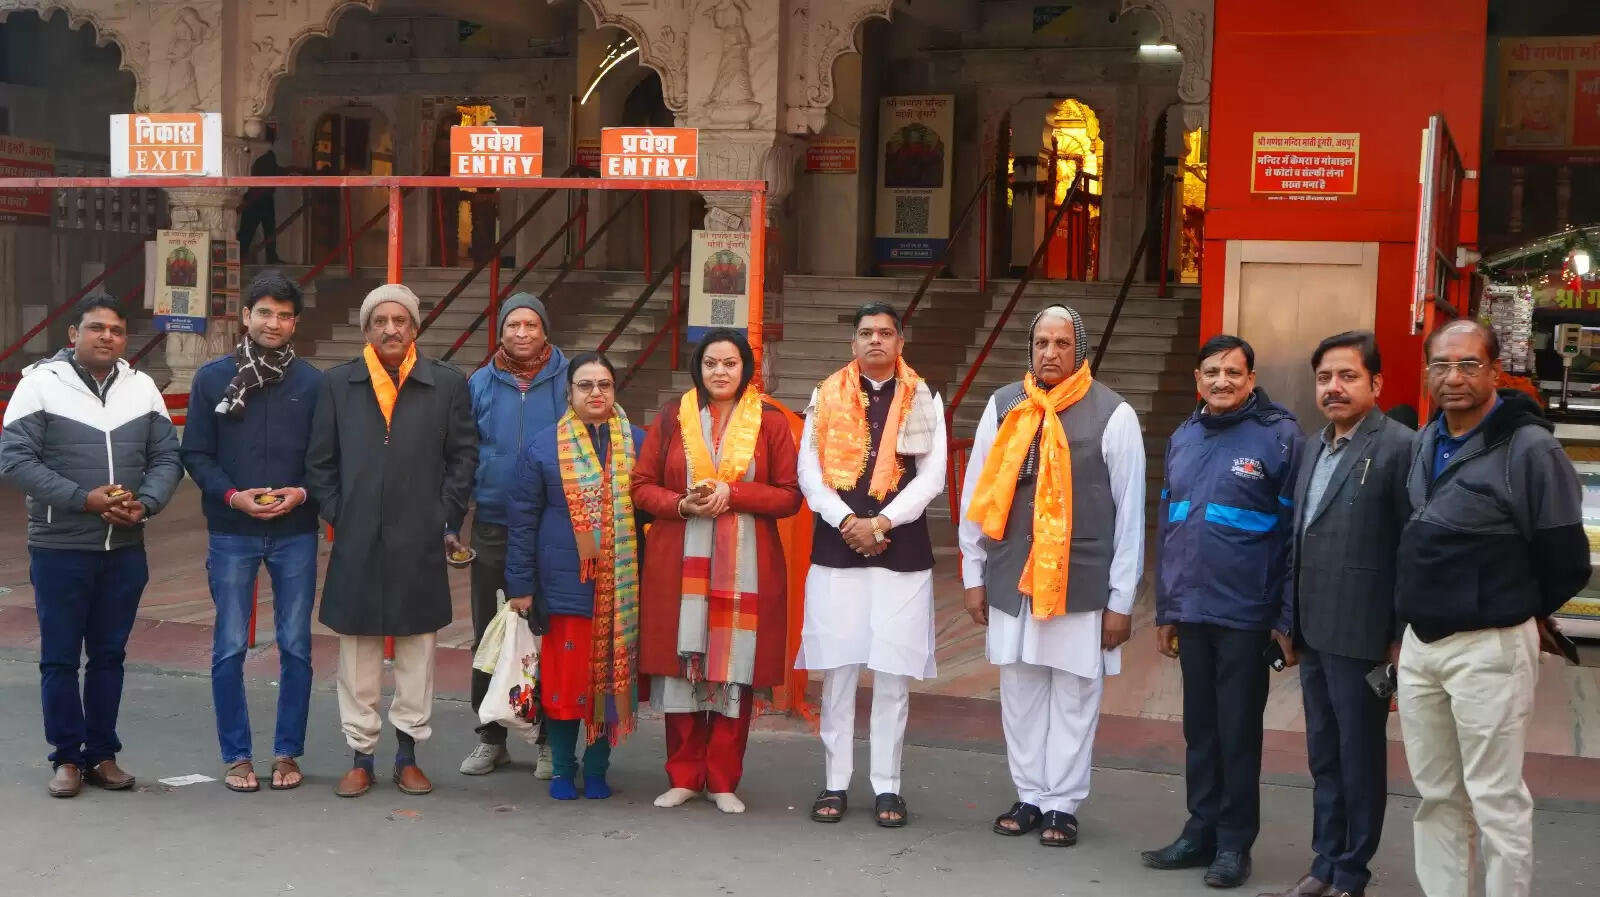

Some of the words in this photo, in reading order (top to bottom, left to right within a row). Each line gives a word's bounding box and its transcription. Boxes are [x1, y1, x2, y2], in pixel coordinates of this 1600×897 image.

[136, 116, 196, 144] निकास
[470, 127, 523, 152] प्रवेश
[621, 129, 677, 153] प्रवेश
[136, 151, 196, 171] EXIT
[458, 155, 534, 175] ENTRY
[608, 157, 688, 177] ENTRY
